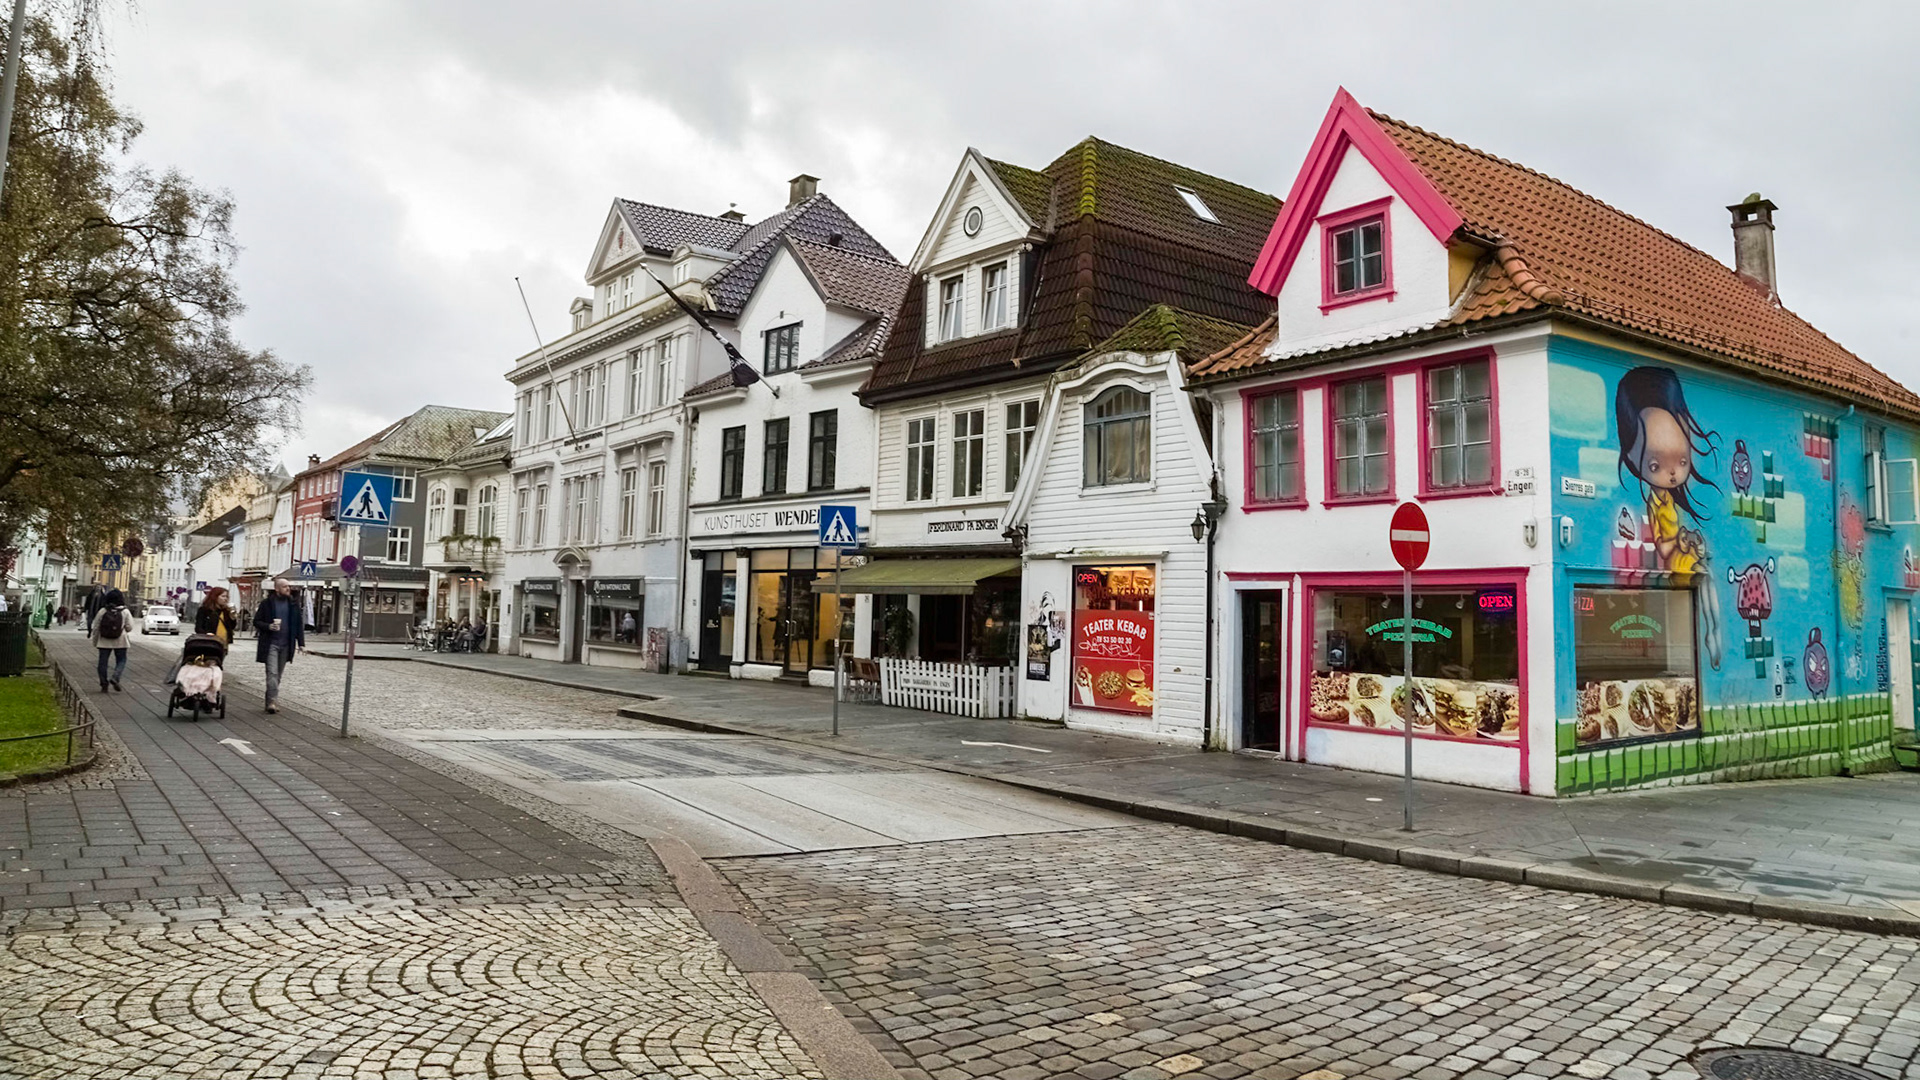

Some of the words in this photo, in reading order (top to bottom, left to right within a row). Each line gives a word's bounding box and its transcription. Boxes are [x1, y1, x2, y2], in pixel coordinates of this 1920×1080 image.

[1508, 480, 1534, 494] Engen
[704, 512, 768, 531] KUNSTHUSET
[775, 508, 821, 527] WENDE
[1077, 573, 1098, 583] OPEN
[1479, 596, 1513, 608] OPEN
[1574, 597, 1594, 611] PIZZA
[1083, 619, 1115, 637] TEATER
[1117, 619, 1147, 640] KEBAB
[1411, 618, 1453, 639] KEBAB
